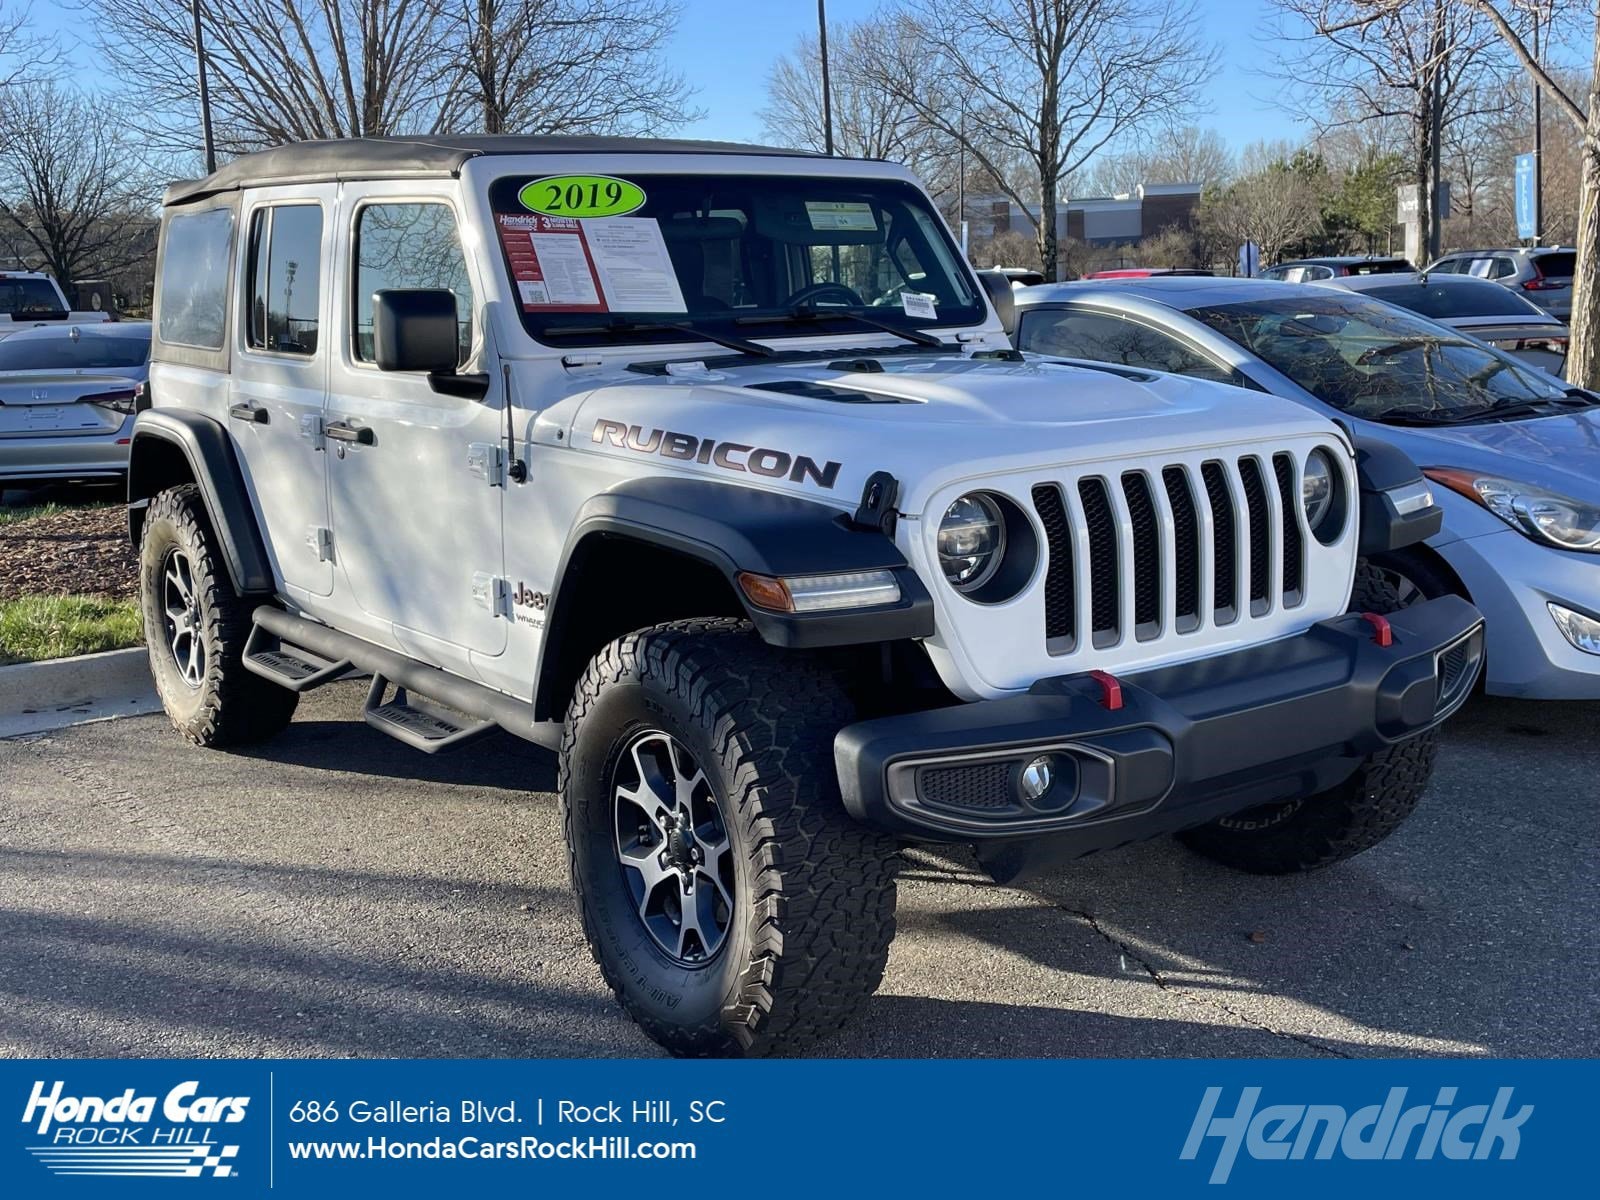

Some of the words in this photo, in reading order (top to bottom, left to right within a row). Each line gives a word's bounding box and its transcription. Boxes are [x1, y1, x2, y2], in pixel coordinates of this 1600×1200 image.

[545, 182, 623, 211] 2019
[499, 215, 538, 226] Hendrick
[591, 418, 842, 490] RUBICON
